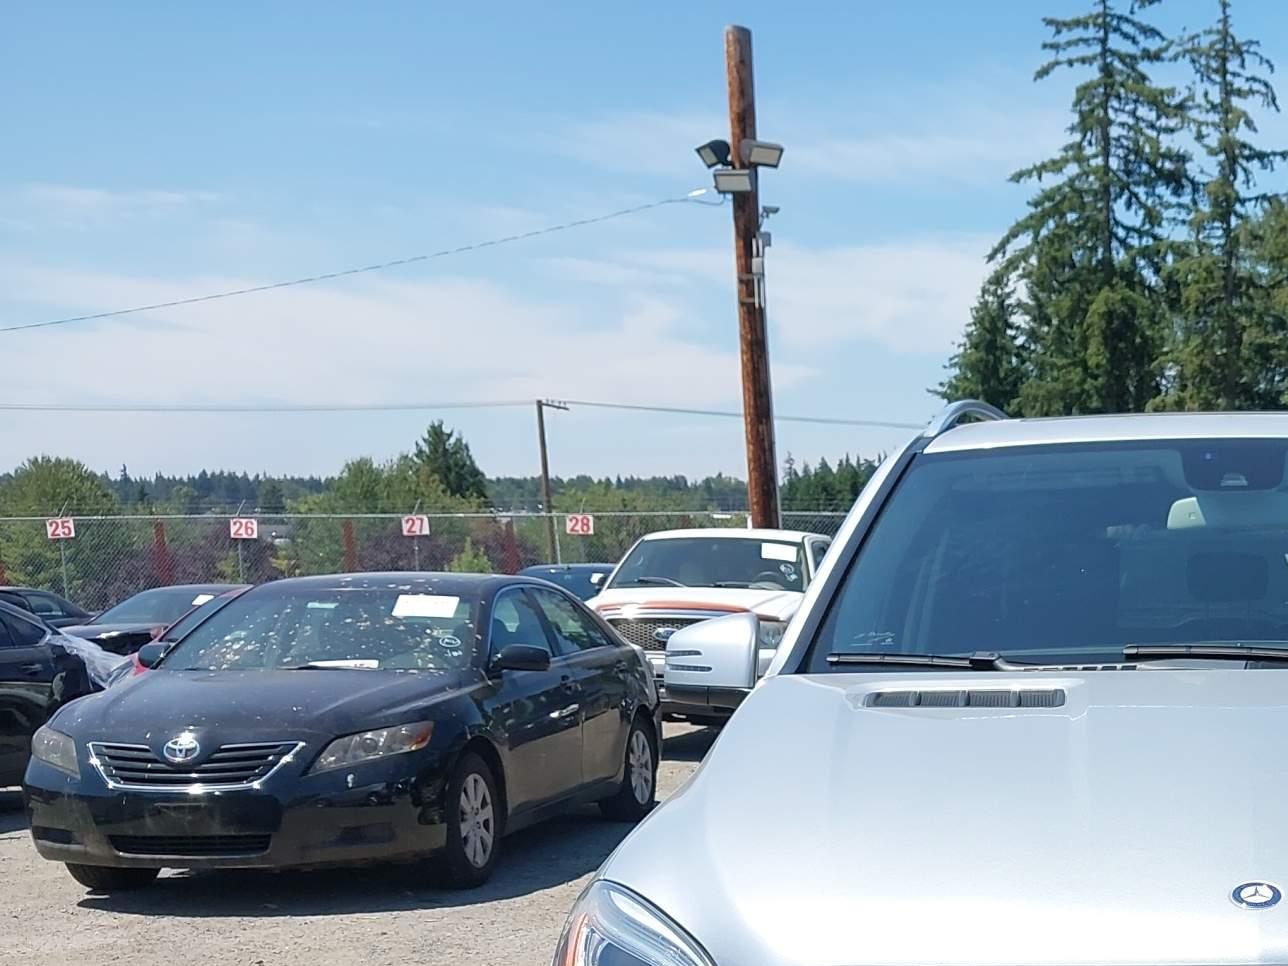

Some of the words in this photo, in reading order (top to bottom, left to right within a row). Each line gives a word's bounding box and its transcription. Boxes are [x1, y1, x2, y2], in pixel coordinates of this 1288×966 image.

[49, 520, 72, 537] 25
[232, 520, 255, 537] 26
[405, 517, 425, 534] 27
[569, 515, 591, 533] 28
